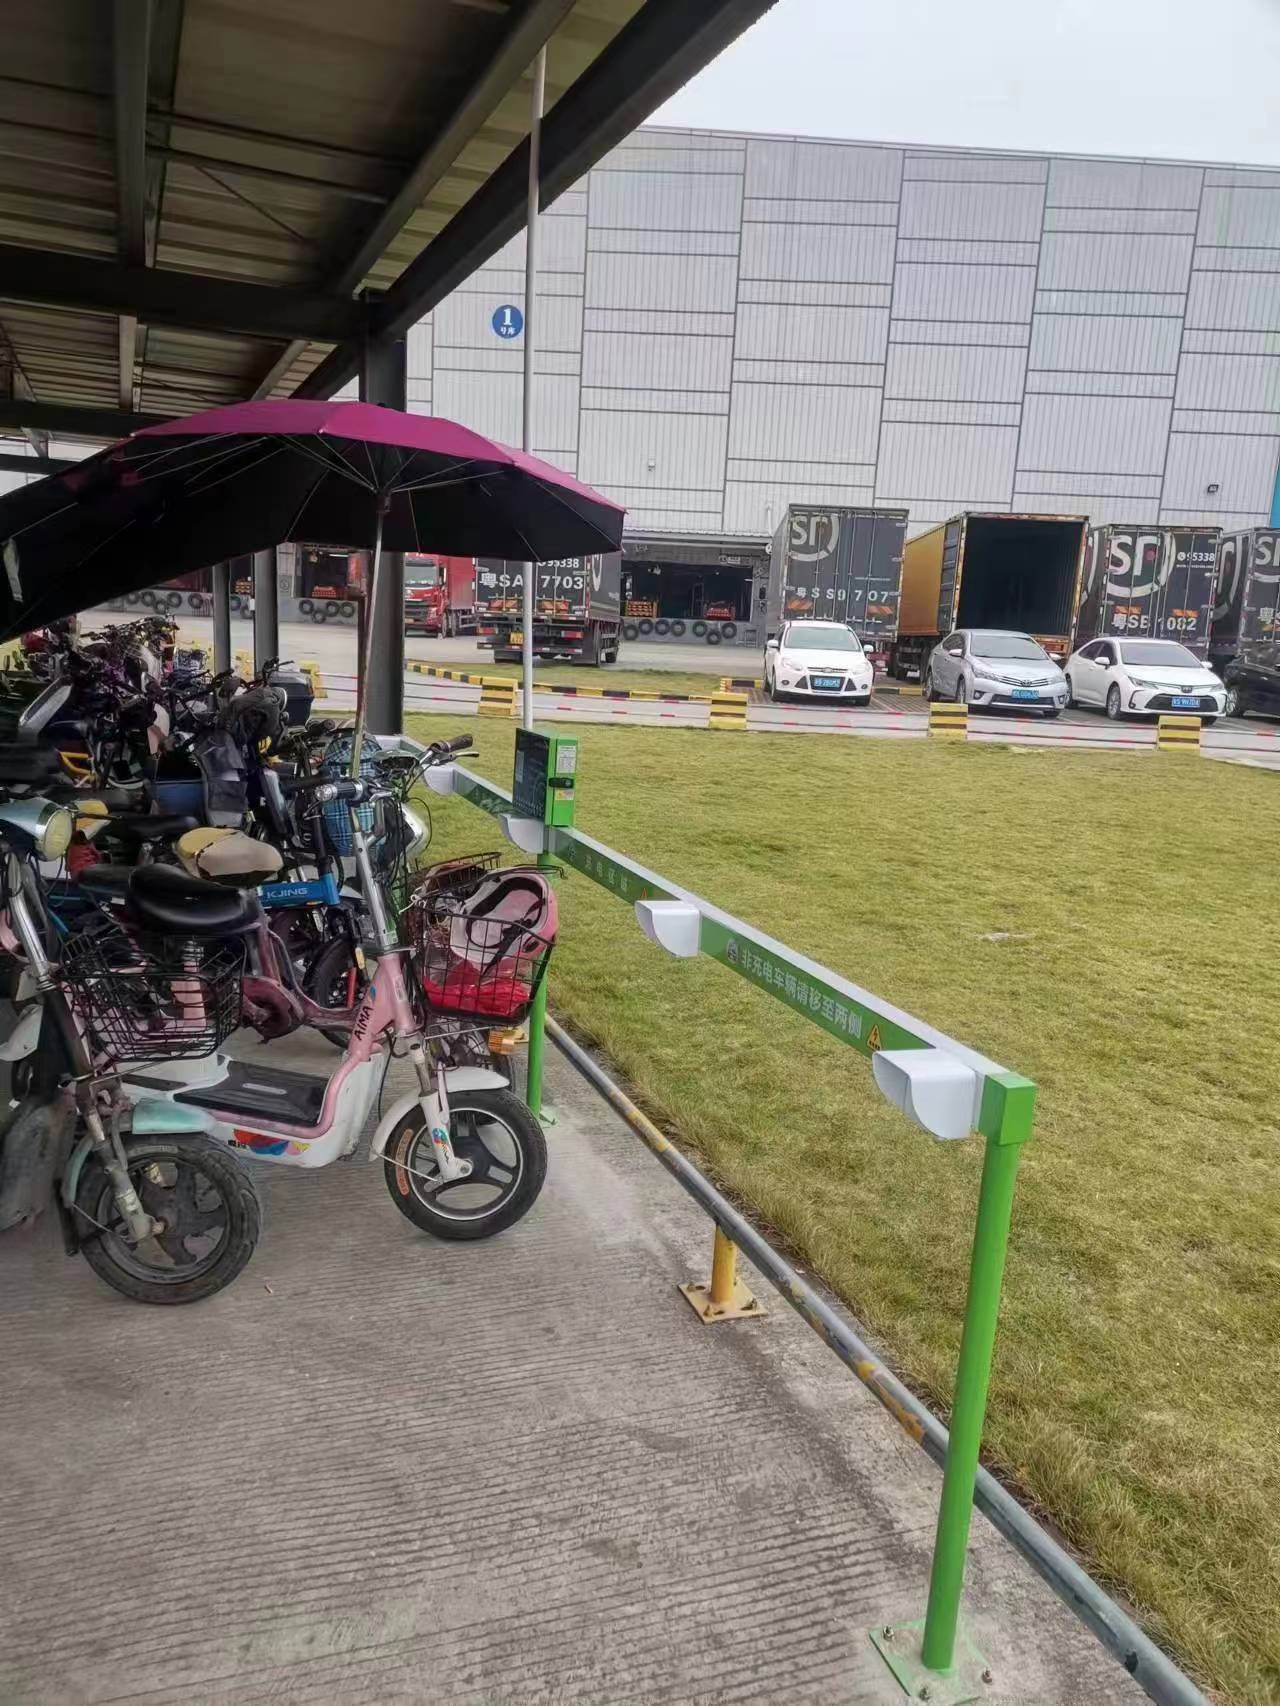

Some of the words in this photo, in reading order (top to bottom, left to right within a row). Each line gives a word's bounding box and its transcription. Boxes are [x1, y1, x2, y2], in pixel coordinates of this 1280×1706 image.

[503, 308, 512, 325] 1
[742, 947, 863, 1039] 非充电车辆请移至两侧
[354, 1005, 375, 1041] AIMA
